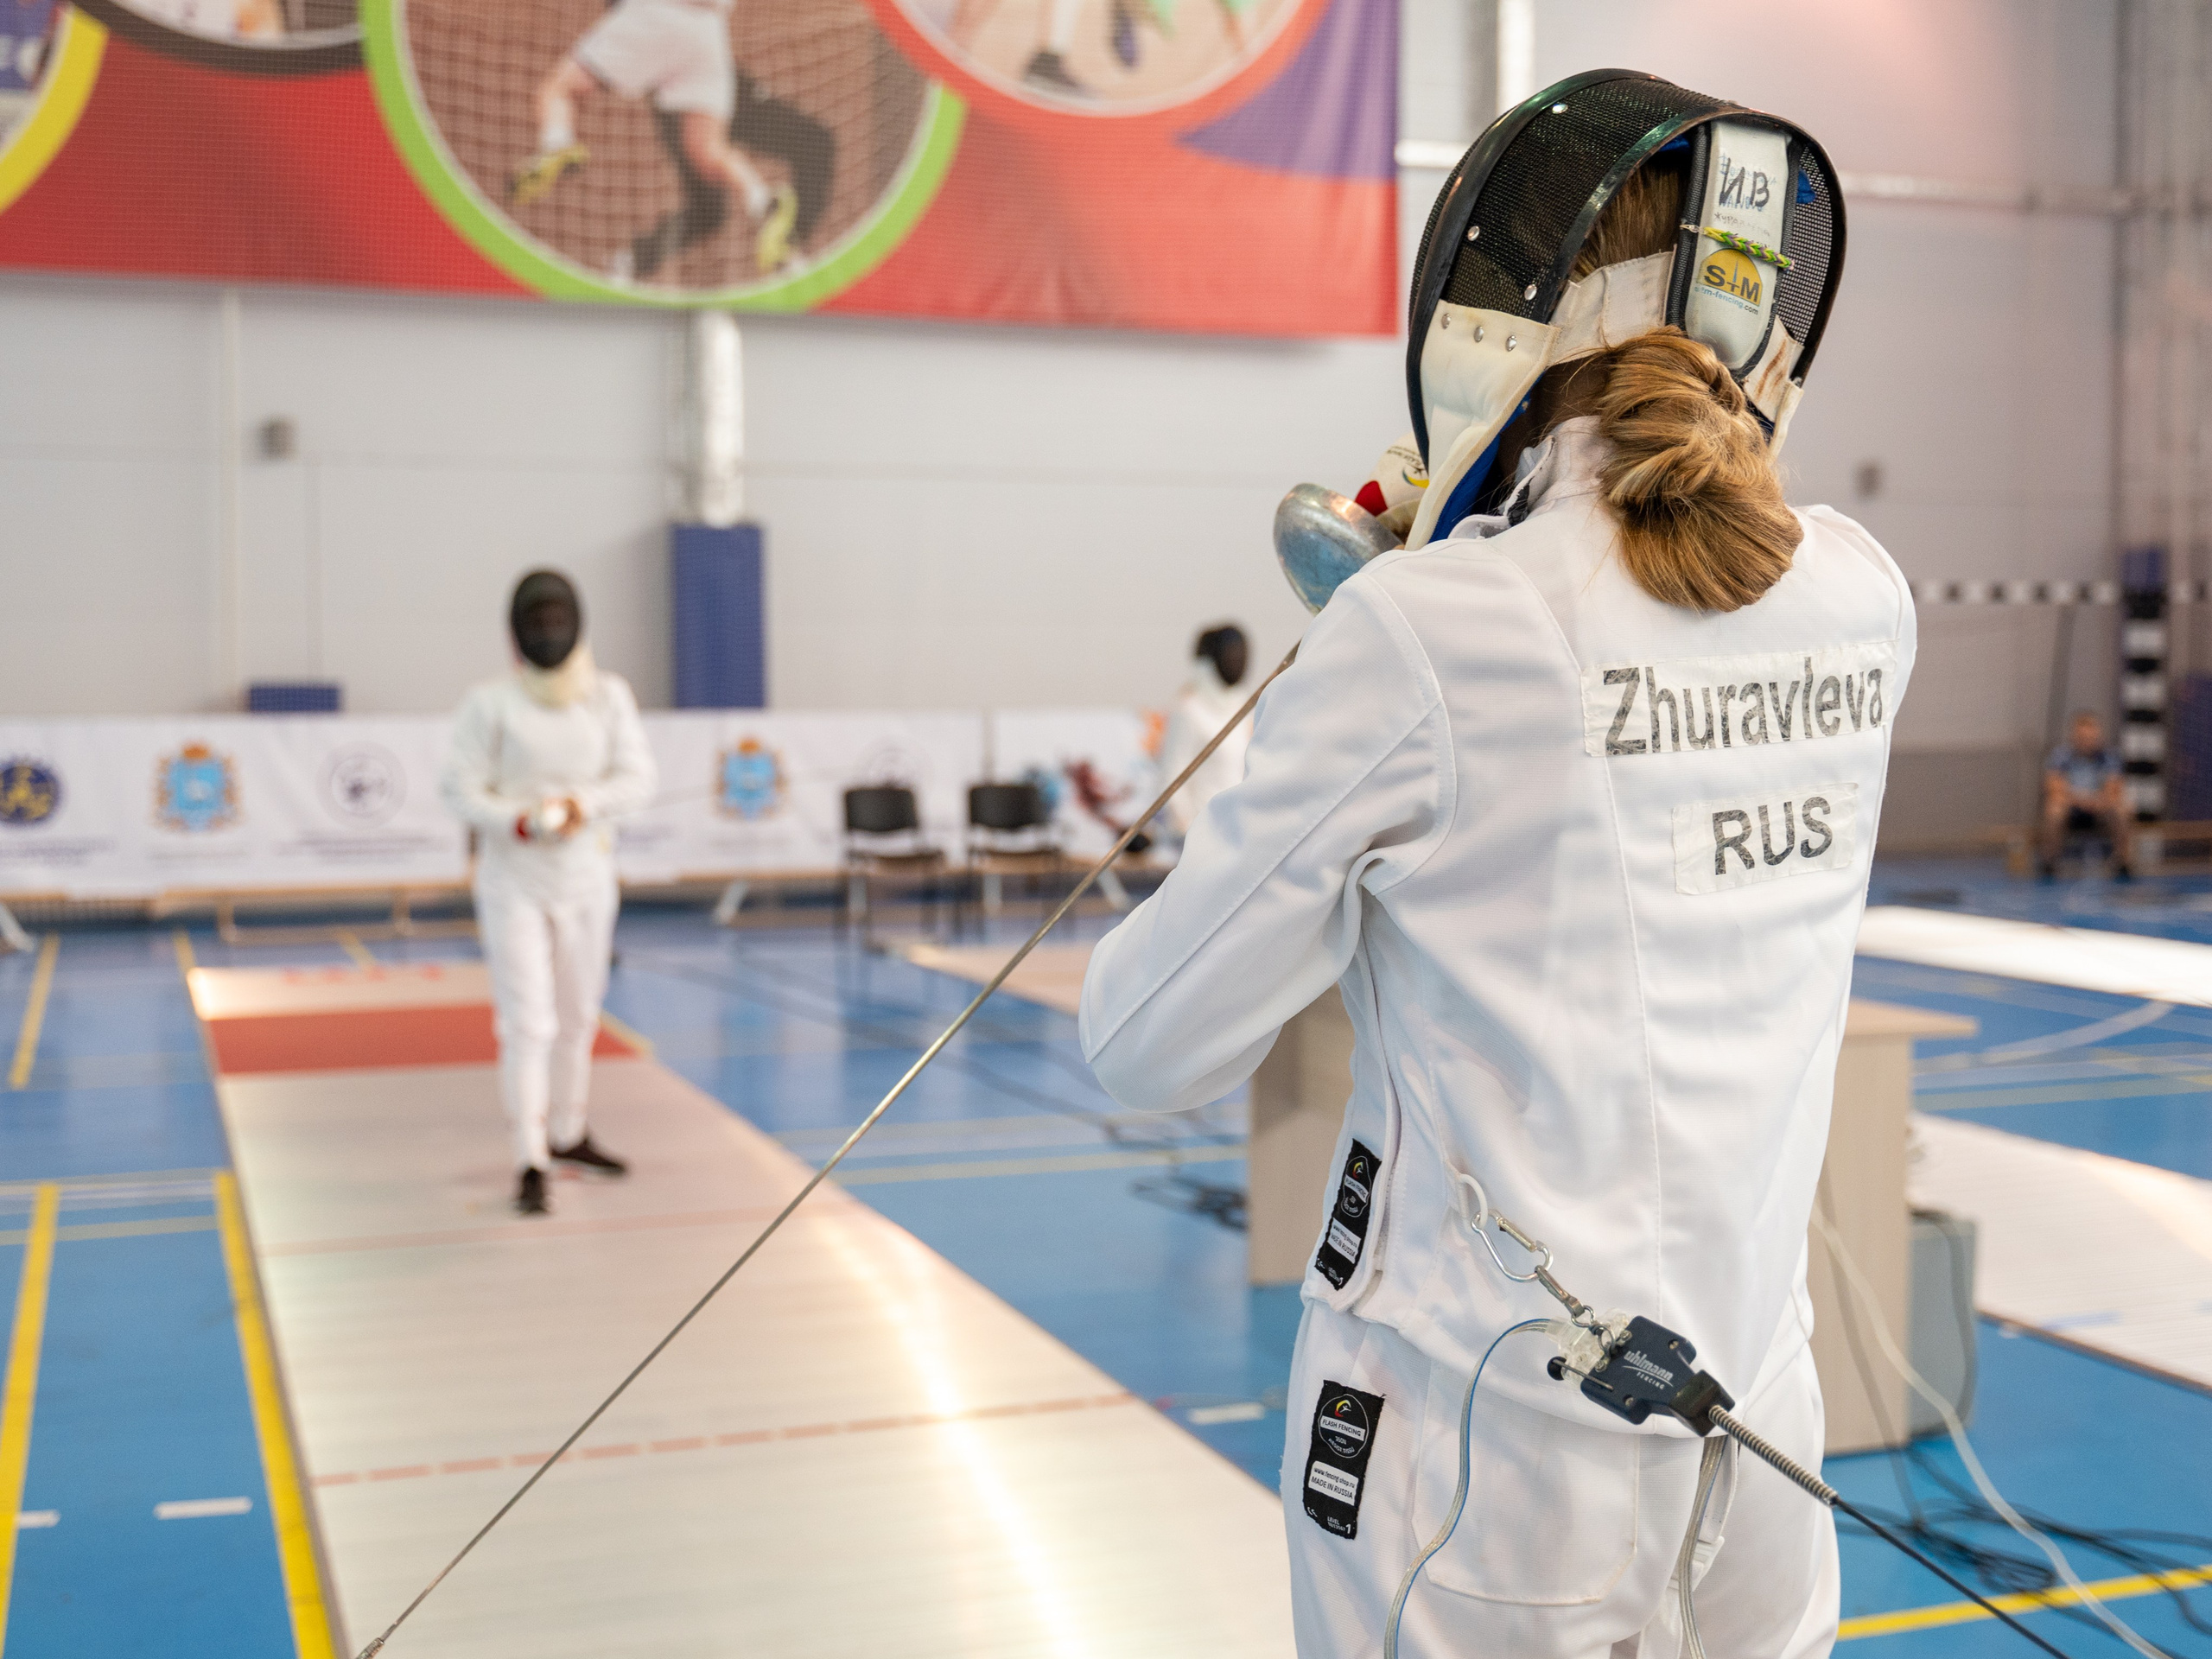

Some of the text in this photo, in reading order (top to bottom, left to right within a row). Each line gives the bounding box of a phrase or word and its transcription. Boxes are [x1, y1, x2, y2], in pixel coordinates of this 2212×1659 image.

[1604, 657, 1883, 756] Zhuravleva
[1712, 796, 1834, 876] RUS
[1624, 1351, 1674, 1382] uhlmann
[1322, 1419, 1362, 1437] FLASH FENCING
[1311, 1476, 1354, 1500] MADE IN RUSSIA
